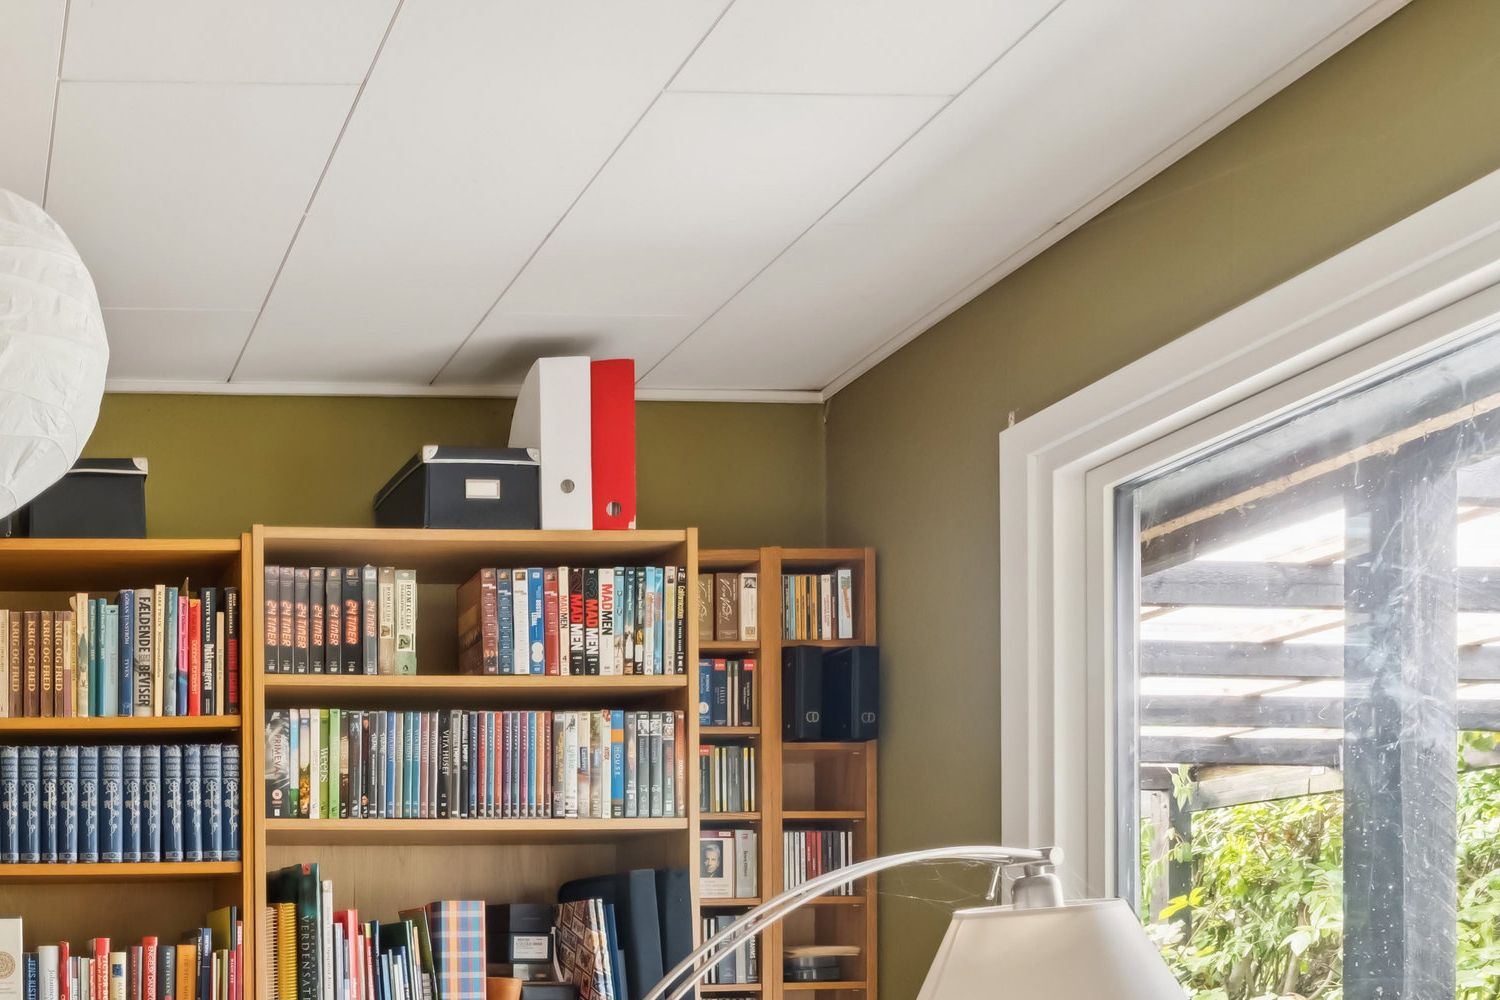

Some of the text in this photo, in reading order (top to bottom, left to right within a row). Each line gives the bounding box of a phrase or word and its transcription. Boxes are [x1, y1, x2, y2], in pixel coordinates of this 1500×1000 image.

[267, 601, 277, 646] 24 TIMER
[282, 601, 292, 646] 24 TIMER
[297, 604, 307, 649] 24 TIMER
[313, 605, 323, 646] 24 TIMER
[329, 604, 339, 646] 24 TIMER
[346, 601, 357, 645] 24 TIMER
[366, 600, 375, 637] 24 TIMER
[11, 620, 20, 692] KRIG OG FRED
[27, 620, 36, 692] KRIG OG FRED
[42, 619, 52, 691] KRIG OG FRED
[54, 619, 63, 692] KRIG OG FRED
[137, 596, 152, 707] FÆLDENDE BEVISER
[441, 729, 449, 776] VITA HUSET
[28, 958, 36, 979] JENS
